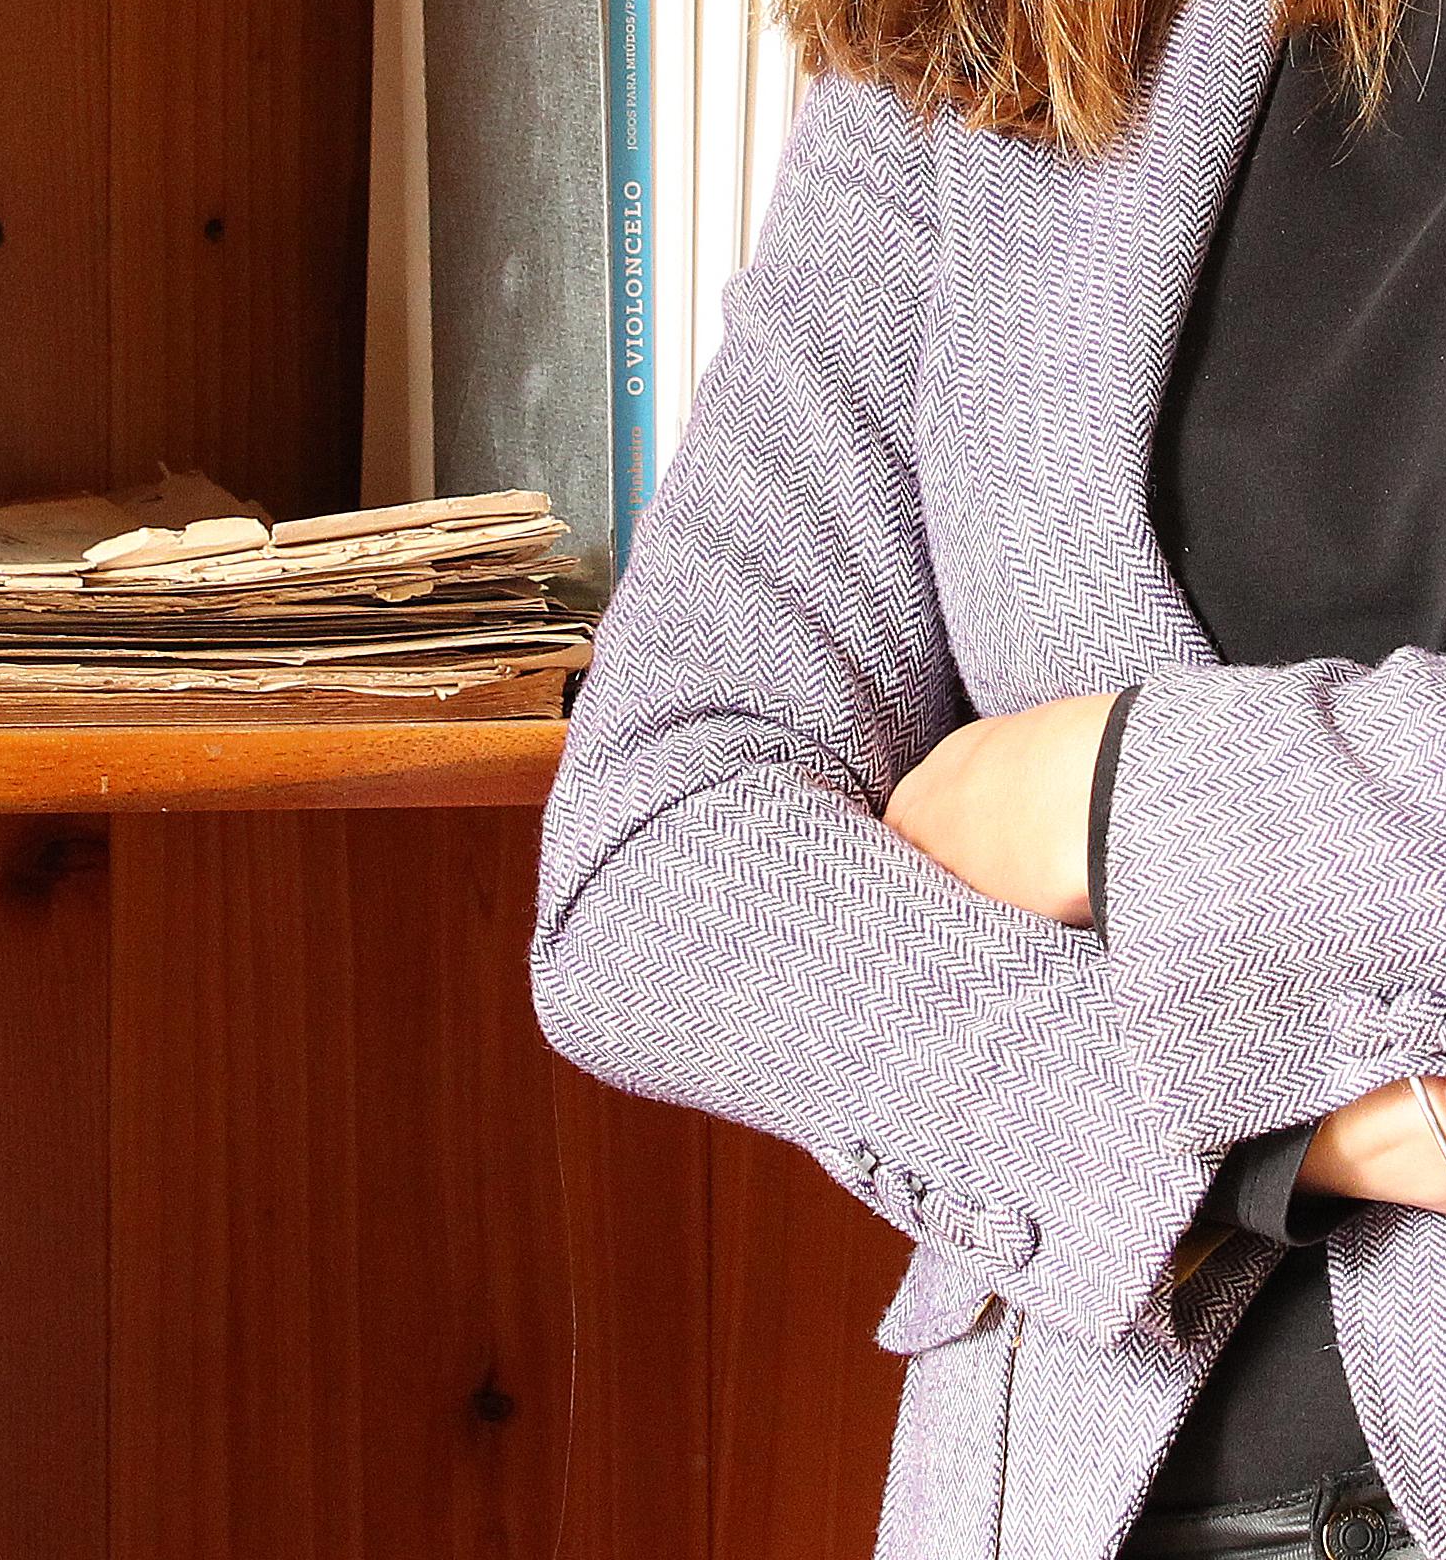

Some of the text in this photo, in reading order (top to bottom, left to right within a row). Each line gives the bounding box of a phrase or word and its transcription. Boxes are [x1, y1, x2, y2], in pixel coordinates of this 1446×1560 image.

[626, 71, 637, 107] PARA
[627, 109, 638, 151] JOGOS
[624, 180, 645, 397] O VIOLONCELO
